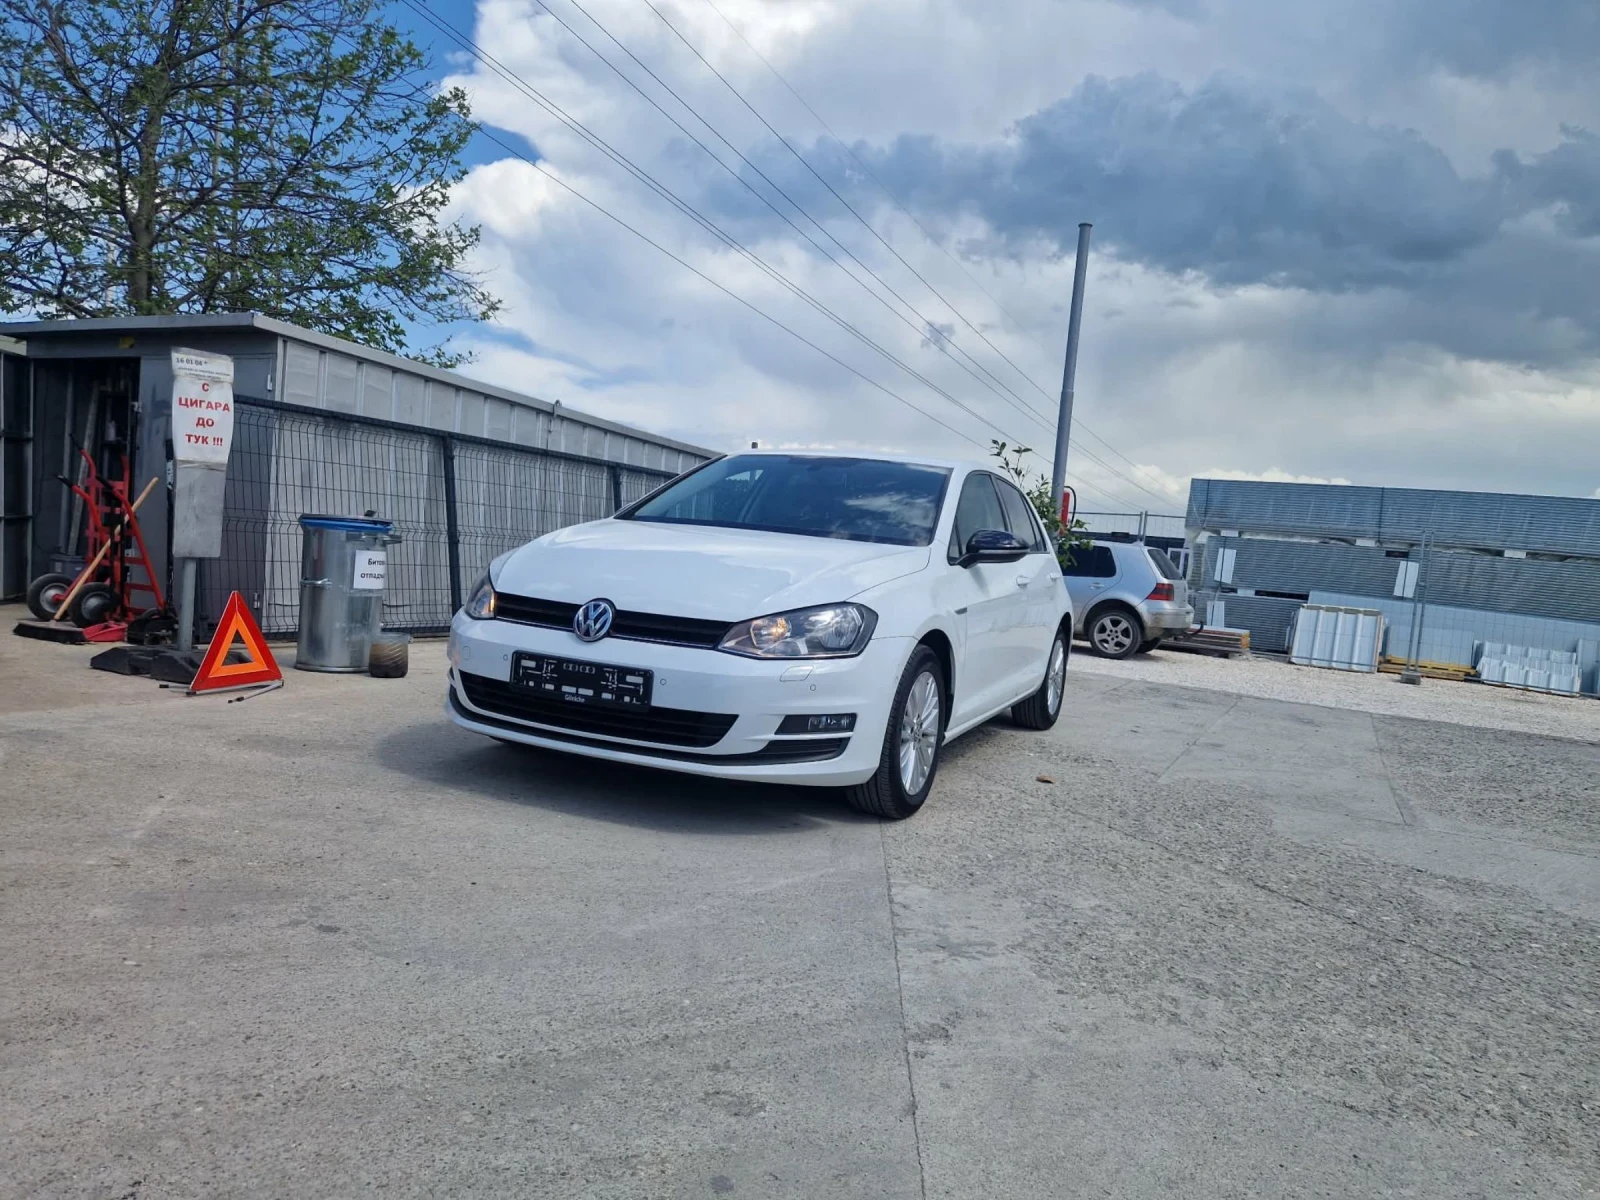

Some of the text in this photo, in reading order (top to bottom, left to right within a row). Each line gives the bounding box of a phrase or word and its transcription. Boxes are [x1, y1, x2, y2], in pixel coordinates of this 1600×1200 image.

[201, 382, 210, 392] С
[178, 396, 231, 413] ЦИГАРА
[195, 417, 215, 428] ДО
[185, 433, 223, 447] ТУК !!!
